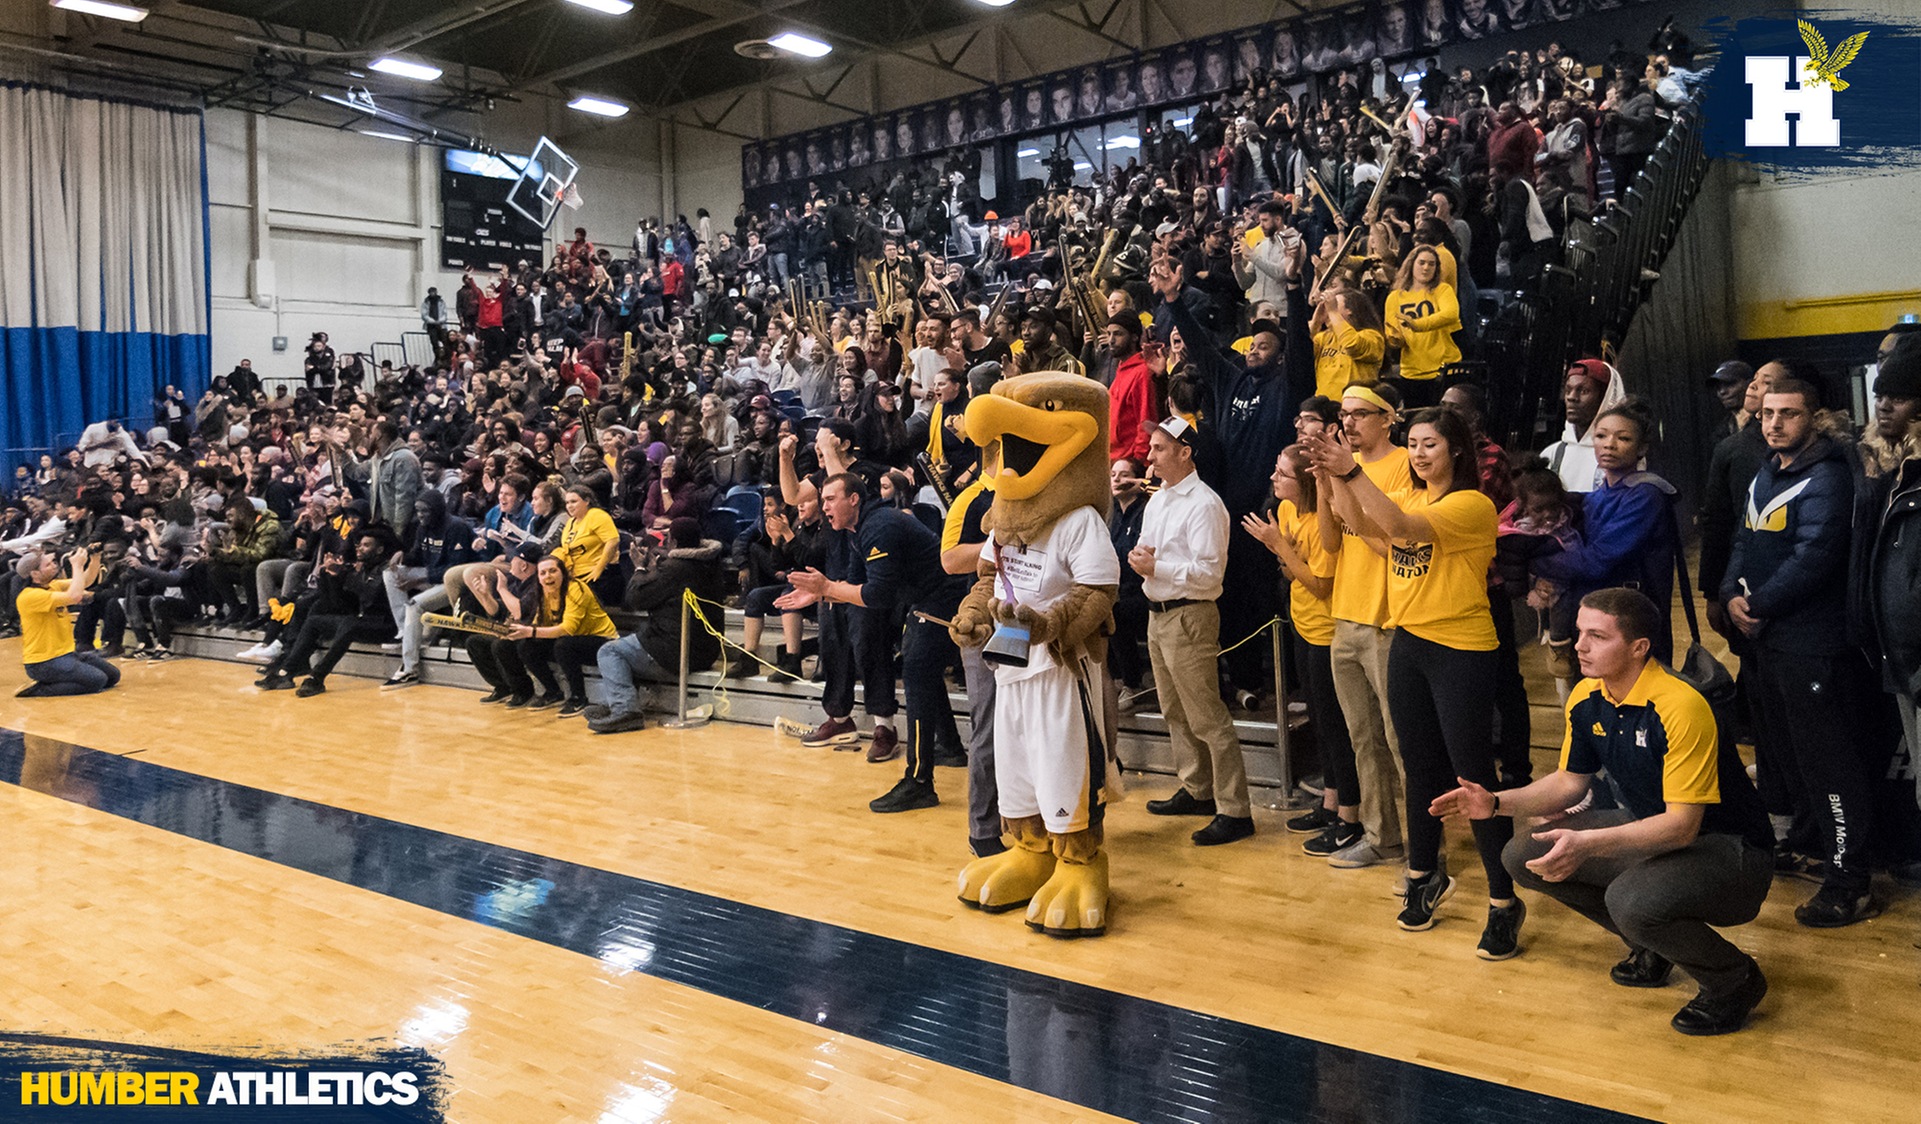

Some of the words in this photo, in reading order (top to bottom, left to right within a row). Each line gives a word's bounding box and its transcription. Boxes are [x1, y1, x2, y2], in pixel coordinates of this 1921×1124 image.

[1400, 300, 1435, 319] 50
[927, 464, 947, 492] HAWKS
[1828, 794, 1846, 824] BMW
